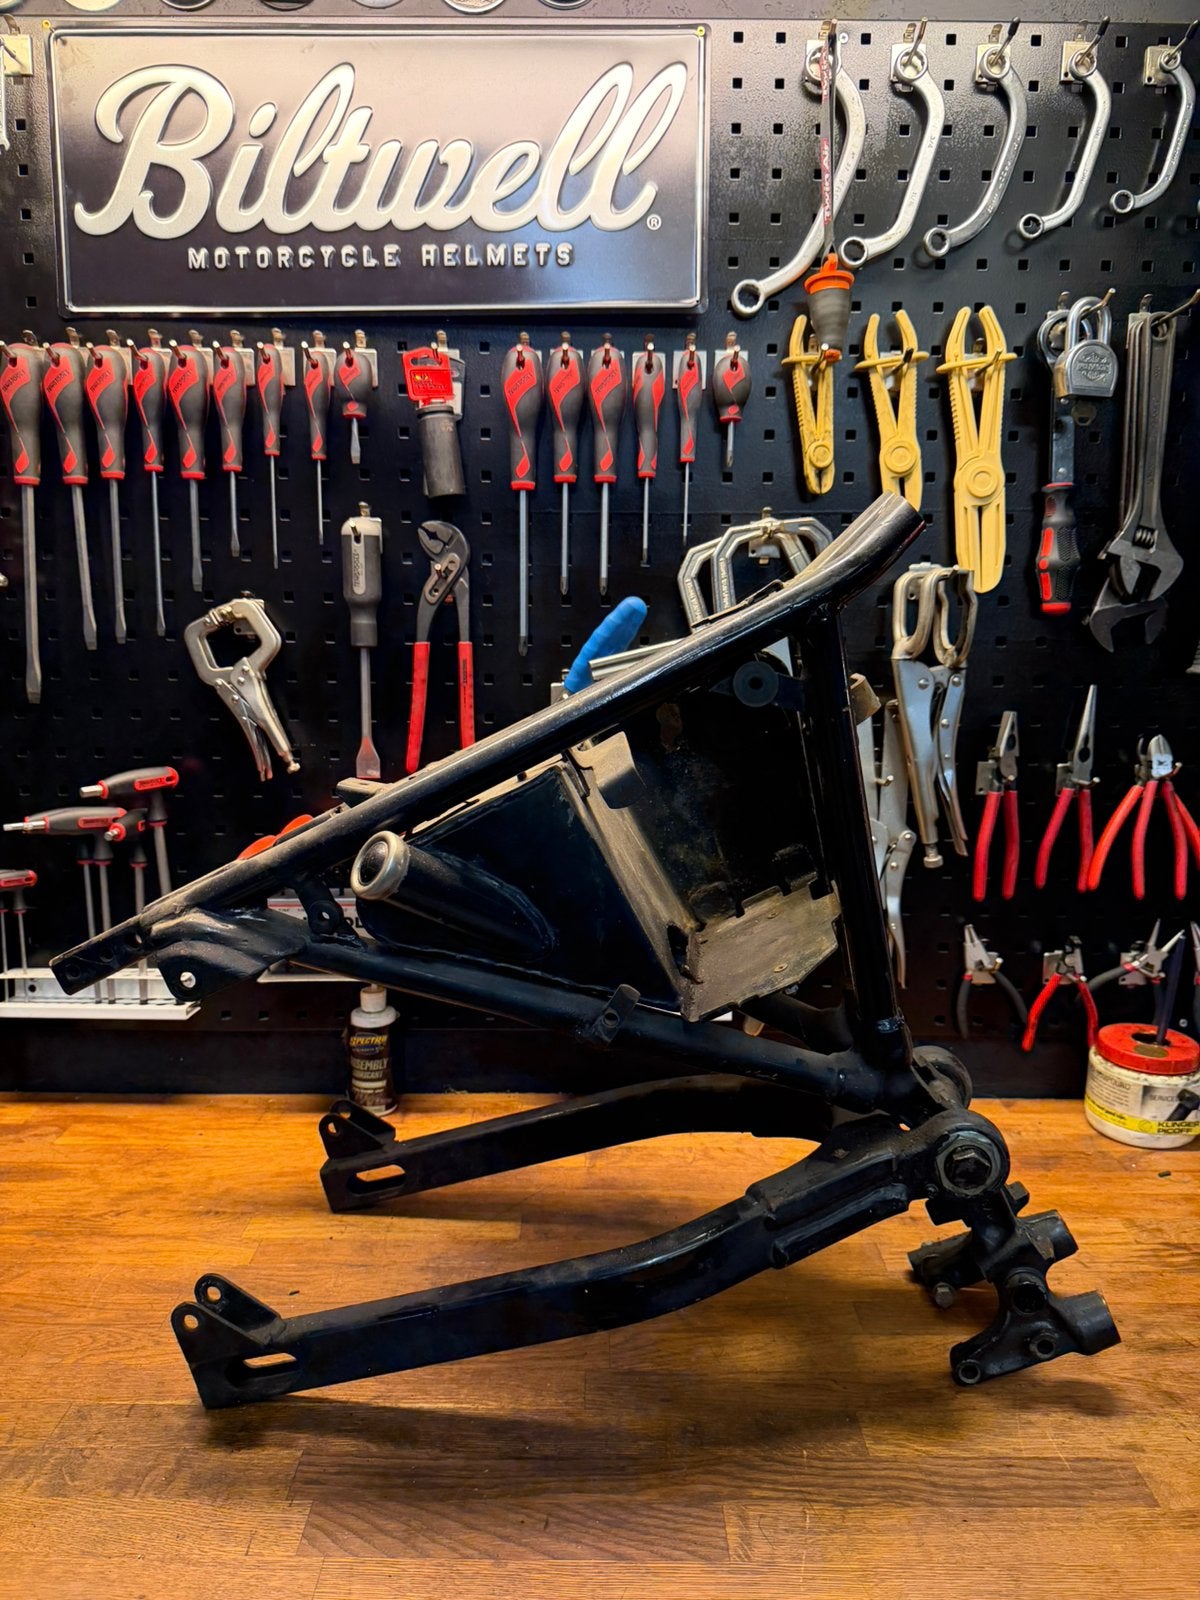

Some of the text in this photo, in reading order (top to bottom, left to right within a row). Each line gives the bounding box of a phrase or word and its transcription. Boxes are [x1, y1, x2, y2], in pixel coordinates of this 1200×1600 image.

[74, 62, 688, 240] Biltwell
[822, 142, 832, 221] Twin Air
[187, 243, 573, 270] MOTORCYCLE HELMETS
